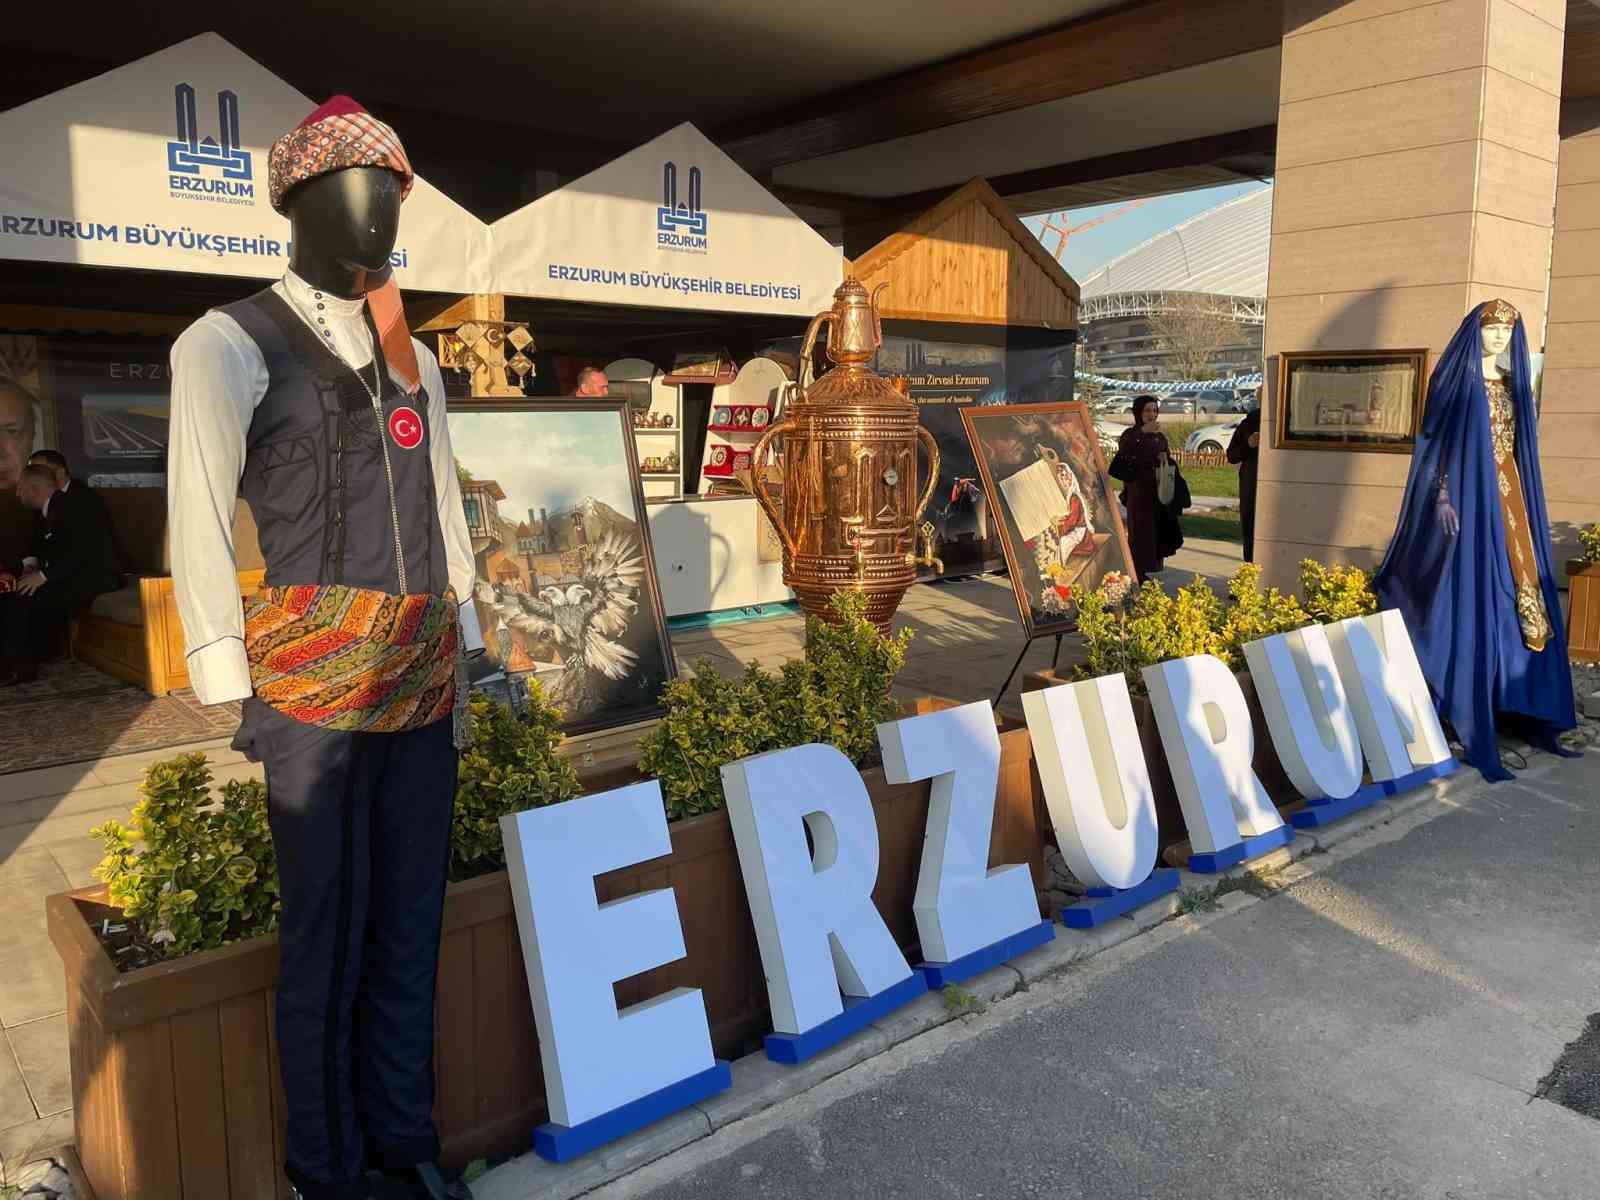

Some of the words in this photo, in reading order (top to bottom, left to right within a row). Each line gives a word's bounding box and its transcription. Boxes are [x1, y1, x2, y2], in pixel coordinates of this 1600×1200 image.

[169, 175, 253, 198] ERZURUM
[0, 215, 119, 242] RZURUM
[125, 223, 281, 257] BÜYÜKŞEHİR
[657, 233, 707, 249] ERZURUM
[548, 264, 626, 286] ERZURUM
[630, 270, 722, 296] BÜYÜKŞEHİR
[725, 281, 801, 300] BELEDİYESİ
[499, 608, 1451, 1128] ERZURUM
